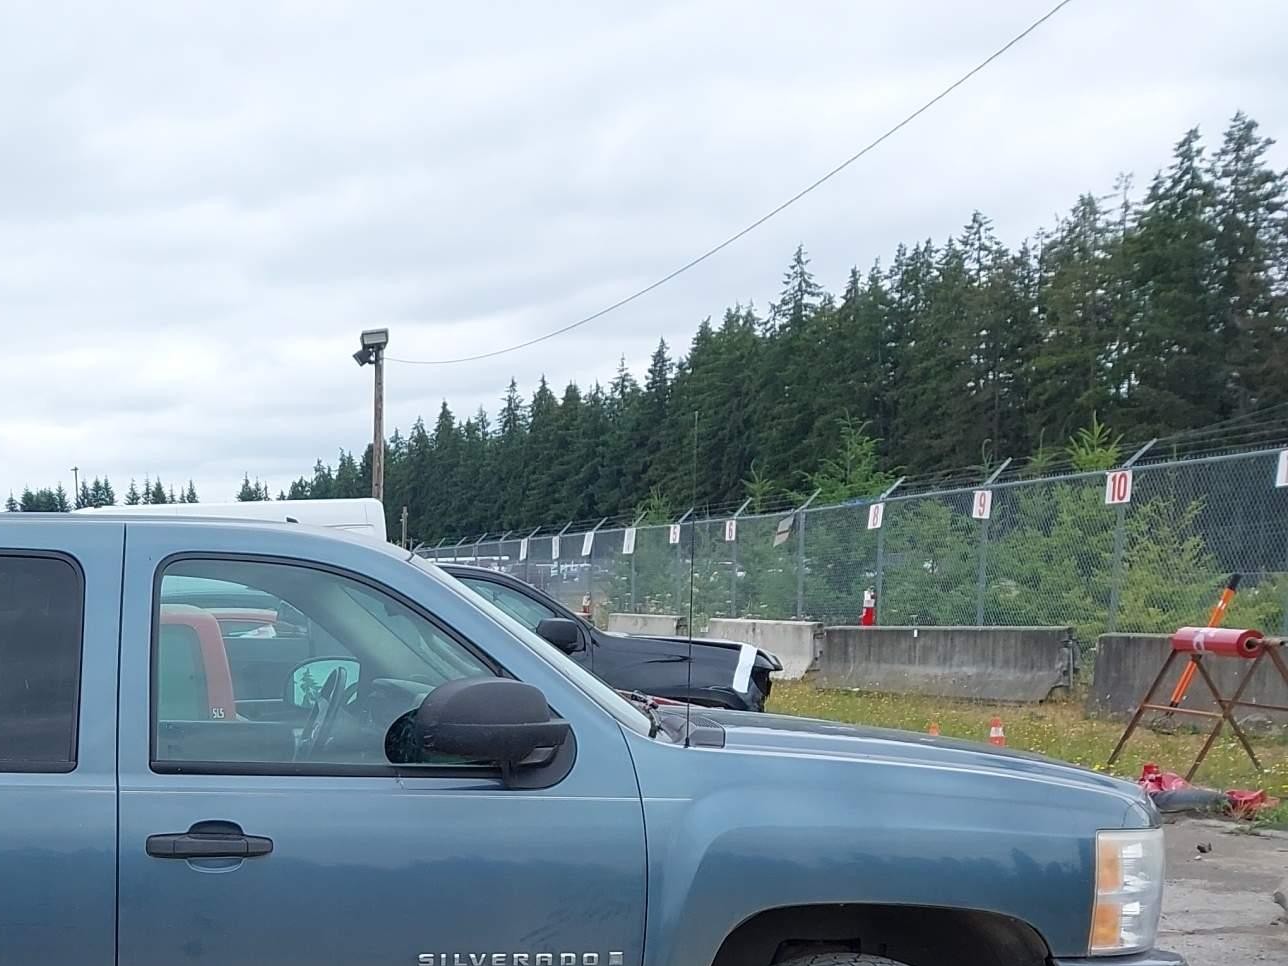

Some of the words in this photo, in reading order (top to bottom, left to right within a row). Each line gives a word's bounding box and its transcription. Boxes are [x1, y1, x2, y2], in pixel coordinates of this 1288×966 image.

[1111, 472, 1128, 502] 10
[872, 505, 880, 527] 8
[978, 492, 987, 517] 9
[418, 953, 599, 966] SILVERADO
